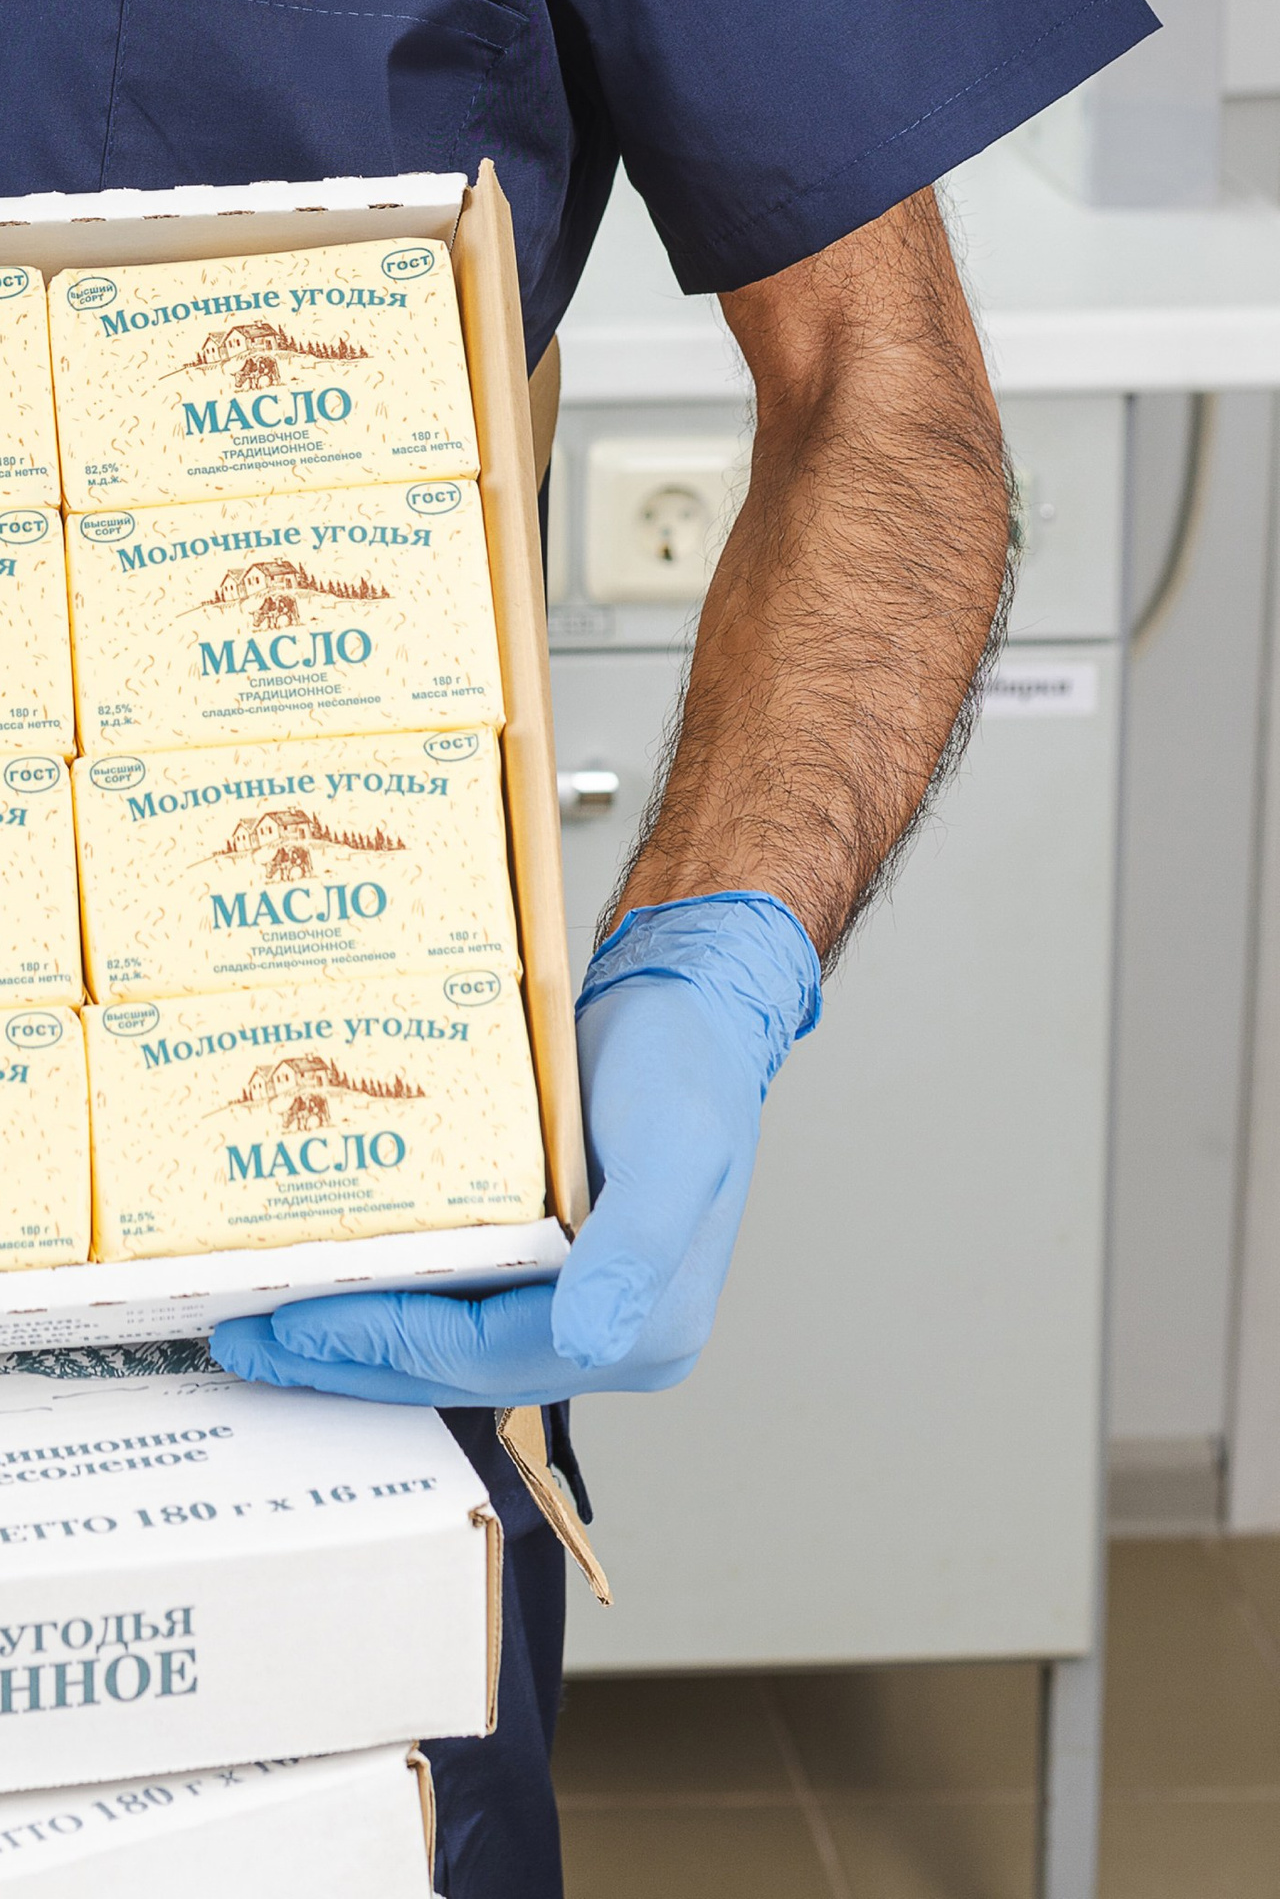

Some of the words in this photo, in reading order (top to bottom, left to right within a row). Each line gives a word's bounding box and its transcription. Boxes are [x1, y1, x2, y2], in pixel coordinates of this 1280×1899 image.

[386, 252, 432, 269] ГОСТ
[66, 283, 114, 298] ВЫСШИЙ
[77, 293, 104, 305] СОРТ
[99, 290, 281, 337] Молочные
[289, 287, 408, 313] угодья
[182, 387, 352, 435] МАСЛО
[232, 429, 310, 447] СЛИВОЧНОЕ
[410, 430, 432, 442] 180
[220, 441, 324, 462] ТРАДИЦИОННОЕ
[391, 444, 428, 457] масса
[429, 440, 464, 452] нетто
[14, 466, 48, 478] нетто
[84, 462, 120, 476] 82,5%
[186, 458, 297, 478] сладко-сливочное
[299, 450, 363, 466] несоленое
[410, 489, 458, 507] ГОСТ
[83, 516, 132, 530] ВЫСШИЙ
[94, 525, 122, 538] СОРТ
[116, 526, 302, 571] Молочные
[310, 525, 432, 550] угодья
[199, 629, 372, 676] МАСЛО
[248, 672, 329, 689] СЛИВОЧНОЕ
[431, 674, 453, 687] 180
[236, 684, 343, 704] ТРАДИЦИОННОЕ
[411, 689, 449, 701] масса
[450, 685, 485, 698] нетто
[8, 706, 30, 719] 180
[97, 702, 133, 716] 82,5%
[201, 701, 314, 720] сладко-сливочное
[316, 694, 382, 710] несоленое
[27, 719, 61, 730] нетто
[427, 735, 476, 754] ГОСТ
[9, 767, 56, 784] ГОСТ
[92, 762, 143, 777] ВЫСШИЙ
[103, 772, 132, 785] СОРТ
[126, 774, 316, 820] Молочные
[325, 772, 449, 799] угодья
[210, 882, 387, 930] МАСЛО
[261, 926, 343, 944] СЛИВОЧНОЕ
[249, 939, 357, 959] ТРАДИЦИОННОЕ
[427, 945, 466, 958] масса
[467, 942, 503, 954] нетто
[38, 973, 73, 985] нетто
[448, 978, 497, 997] ГОСТ
[10, 1022, 59, 1040] ГОСТ
[139, 1019, 334, 1068] Молочные
[343, 1016, 470, 1045] угодья
[226, 1130, 406, 1181] МАСЛО
[133, 1501, 219, 1529] 180
[231, 1501, 253, 1517] г
[305, 1484, 358, 1508] 16
[367, 1476, 438, 1499] шт
[89, 1783, 176, 1823] 180
